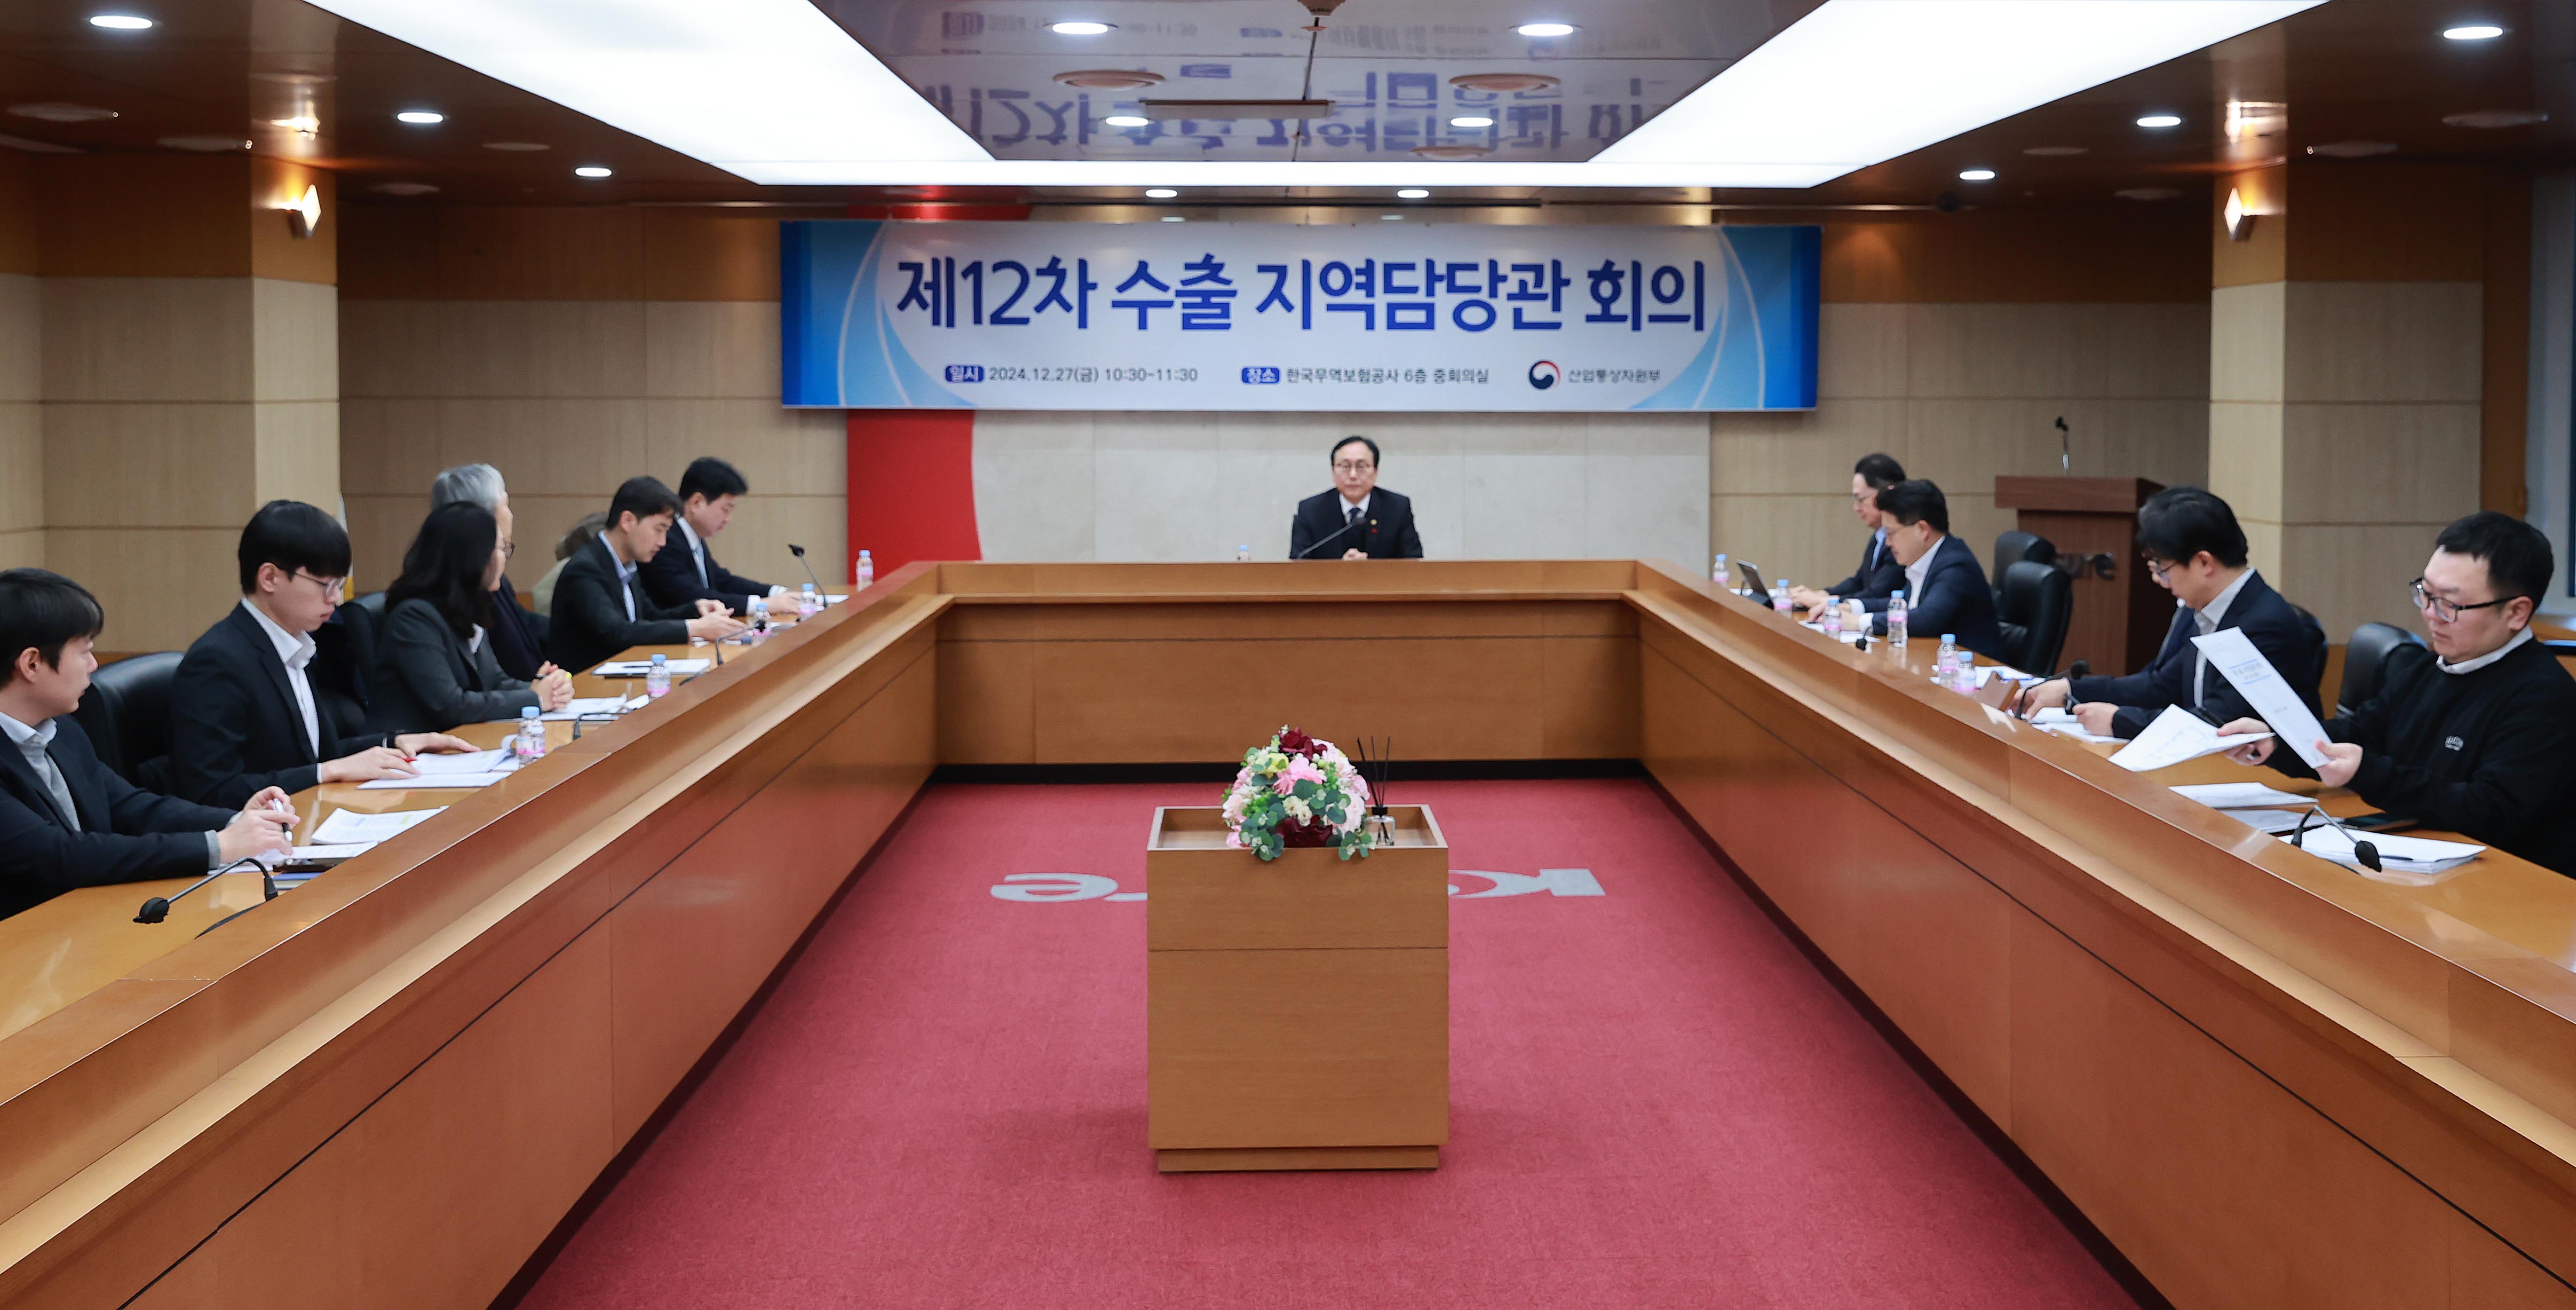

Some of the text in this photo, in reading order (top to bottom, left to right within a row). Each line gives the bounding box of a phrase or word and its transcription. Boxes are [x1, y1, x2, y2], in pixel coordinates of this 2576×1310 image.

[898, 254, 1705, 332] 제12차 수출 지역담당관 회의
[949, 366, 979, 383] 일시
[989, 367, 1099, 383] 2024.12.27(금)
[1247, 367, 1489, 384] 장소 한국무역보험공사 6층 중회의실
[1568, 368, 1661, 384] 산업통상자원부
